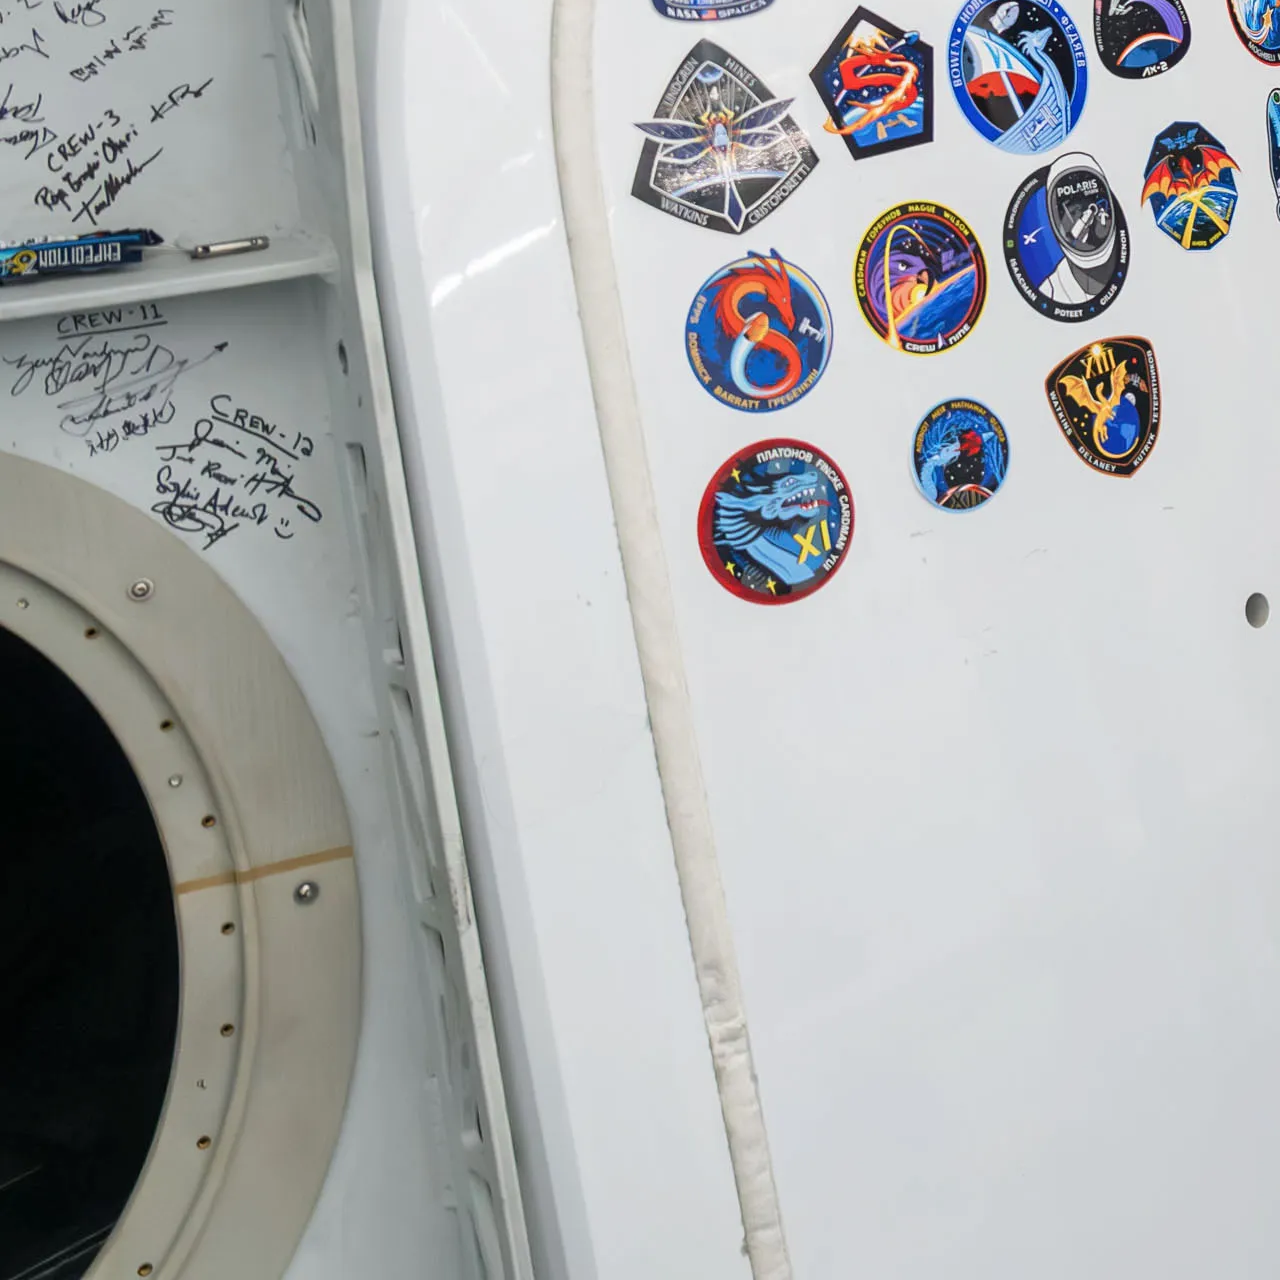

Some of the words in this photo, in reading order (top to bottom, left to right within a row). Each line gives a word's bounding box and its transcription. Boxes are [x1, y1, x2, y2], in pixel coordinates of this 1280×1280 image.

[666, 6, 700, 19] NASA
[718, 0, 768, 18] SPACEX
[1060, 15, 1086, 68] ФЕДЯЕВ
[1095, 15, 1105, 53] WHITSON
[663, 56, 700, 107] LINDGREN
[725, 57, 757, 87] HINES
[951, 38, 963, 88] BOWEN
[660, 196, 710, 226] WATKINS
[747, 162, 813, 225] CRISTOFORETTI
[1057, 179, 1098, 197] POLARIS
[908, 204, 937, 214] HAGUE
[943, 210, 970, 236] WILSON
[859, 250, 867, 297] CARDMAN
[1009, 258, 1037, 302] ISAACMAN
[1054, 307, 1083, 318] POTEET
[1100, 284, 1118, 306] GILLIS
[687, 331, 713, 385] DOMINICK
[713, 384, 761, 410] BARRATT
[905, 341, 937, 353] CREW
[1146, 349, 1160, 424] ТЕТЕРЯТНИКОВ
[1049, 389, 1074, 437] WATKINS
[1077, 445, 1117, 473] DELANEY
[1133, 432, 1157, 467] KUTRYK
[756, 447, 814, 464] ПЛАТОНОВ
[815, 458, 844, 492] FINCKE
[793, 519, 832, 565] XI
[835, 494, 851, 549] CARDMAN
[823, 553, 840, 572] YUI
